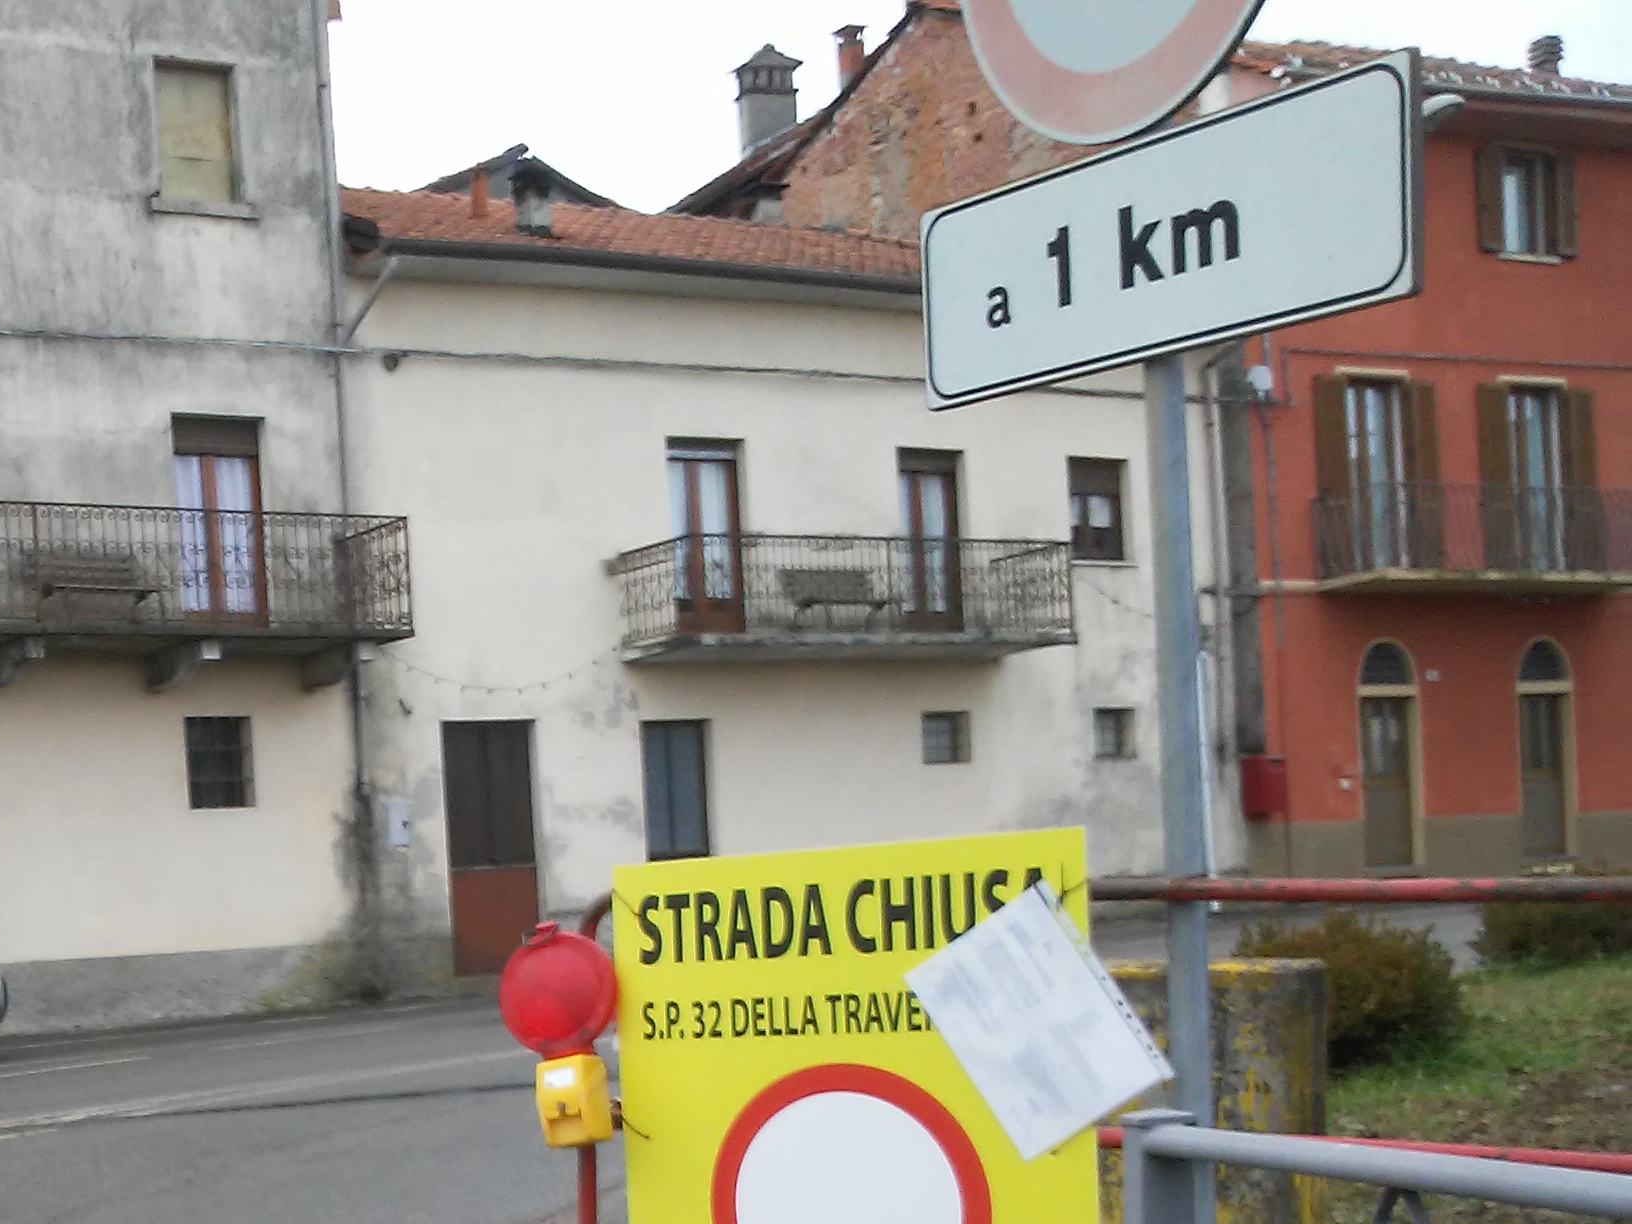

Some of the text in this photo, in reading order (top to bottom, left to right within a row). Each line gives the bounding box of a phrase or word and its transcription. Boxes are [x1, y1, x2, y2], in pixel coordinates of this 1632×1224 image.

[986, 199, 1241, 328] a 1 km
[637, 866, 1045, 965] STRADA CHIUS
[641, 1001, 684, 1040] S.P.
[691, 1000, 723, 1039] 32
[730, 995, 819, 1038] DELLA
